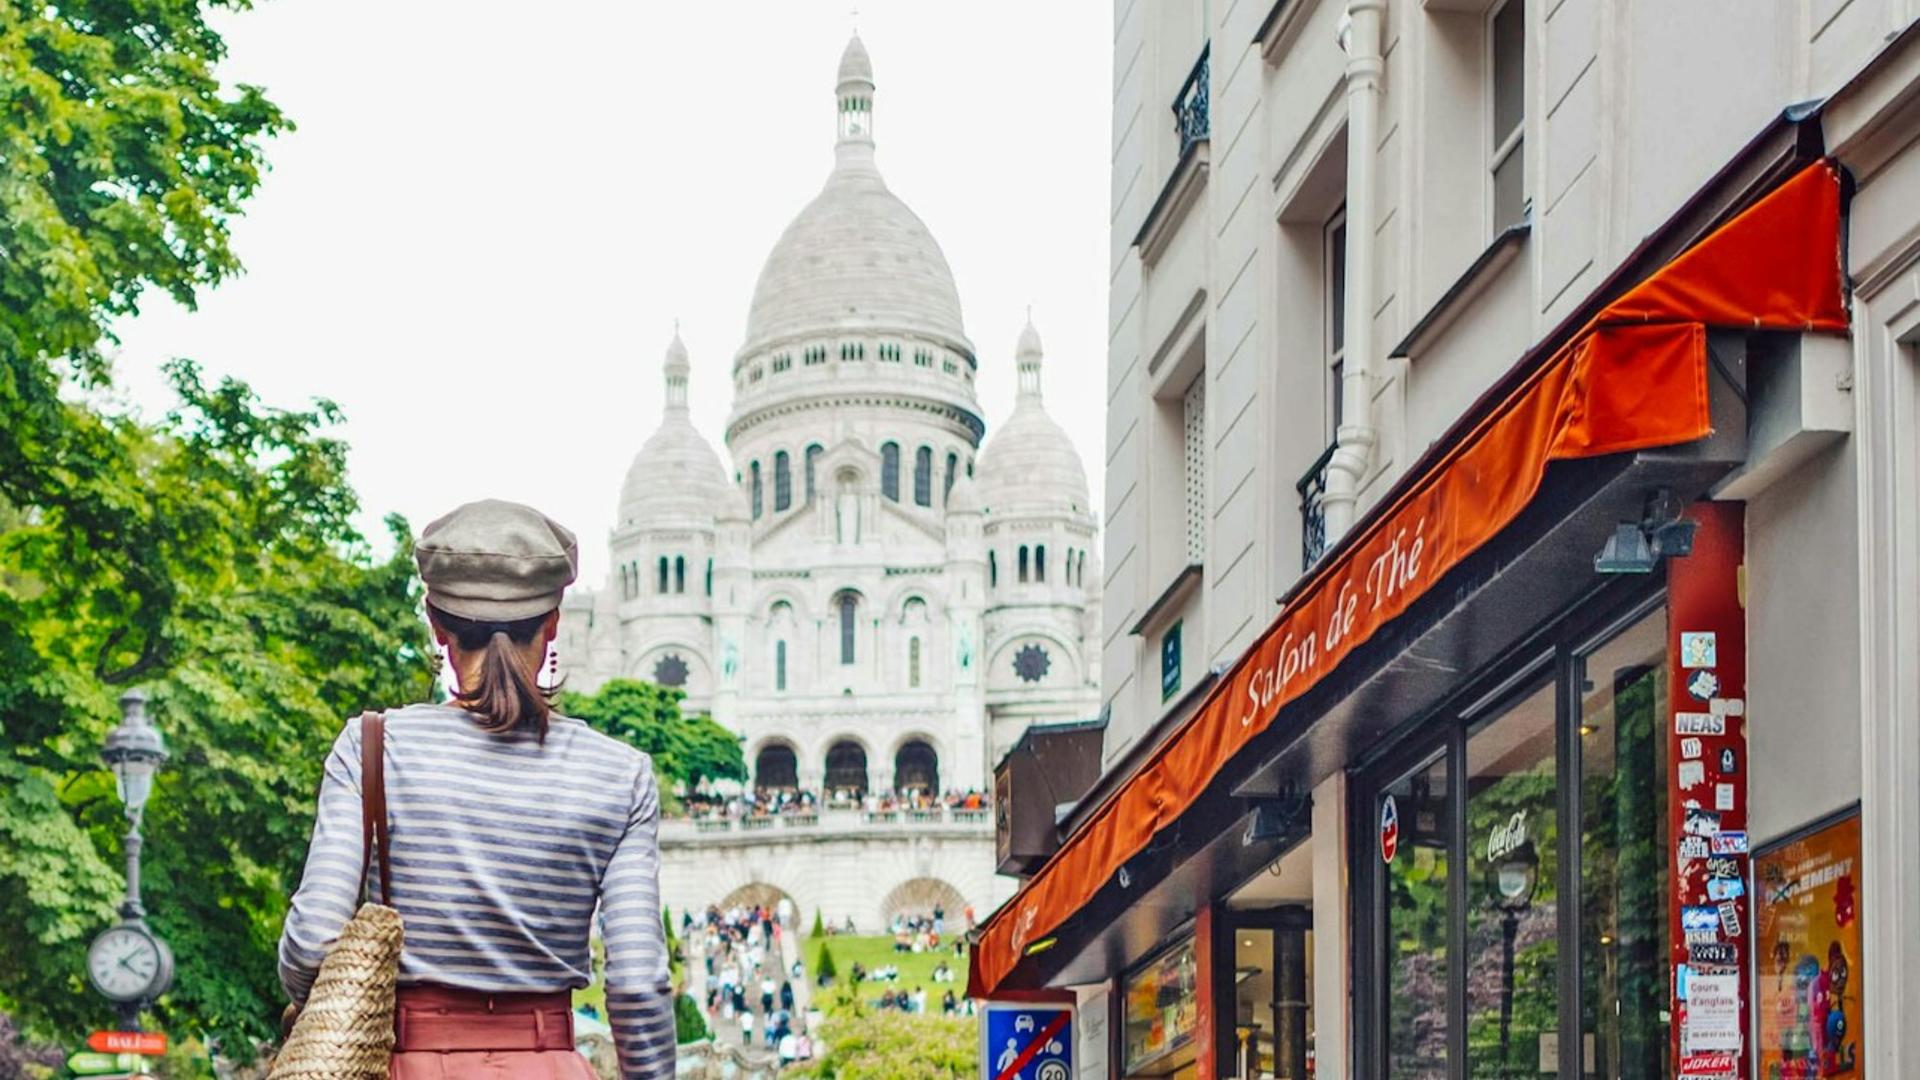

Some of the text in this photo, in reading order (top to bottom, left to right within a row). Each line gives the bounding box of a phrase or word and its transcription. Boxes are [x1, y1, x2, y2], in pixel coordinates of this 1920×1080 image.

[1242, 632, 1317, 727] Salon
[1326, 579, 1358, 651] de
[1366, 517, 1425, 612] Thé
[1678, 714, 1723, 733] NEAS
[1691, 983, 1719, 992] Cours
[1691, 997, 1734, 1007] d'anglais
[1683, 1056, 1730, 1070] JOKER
[1045, 1070, 1063, 1080] 20
